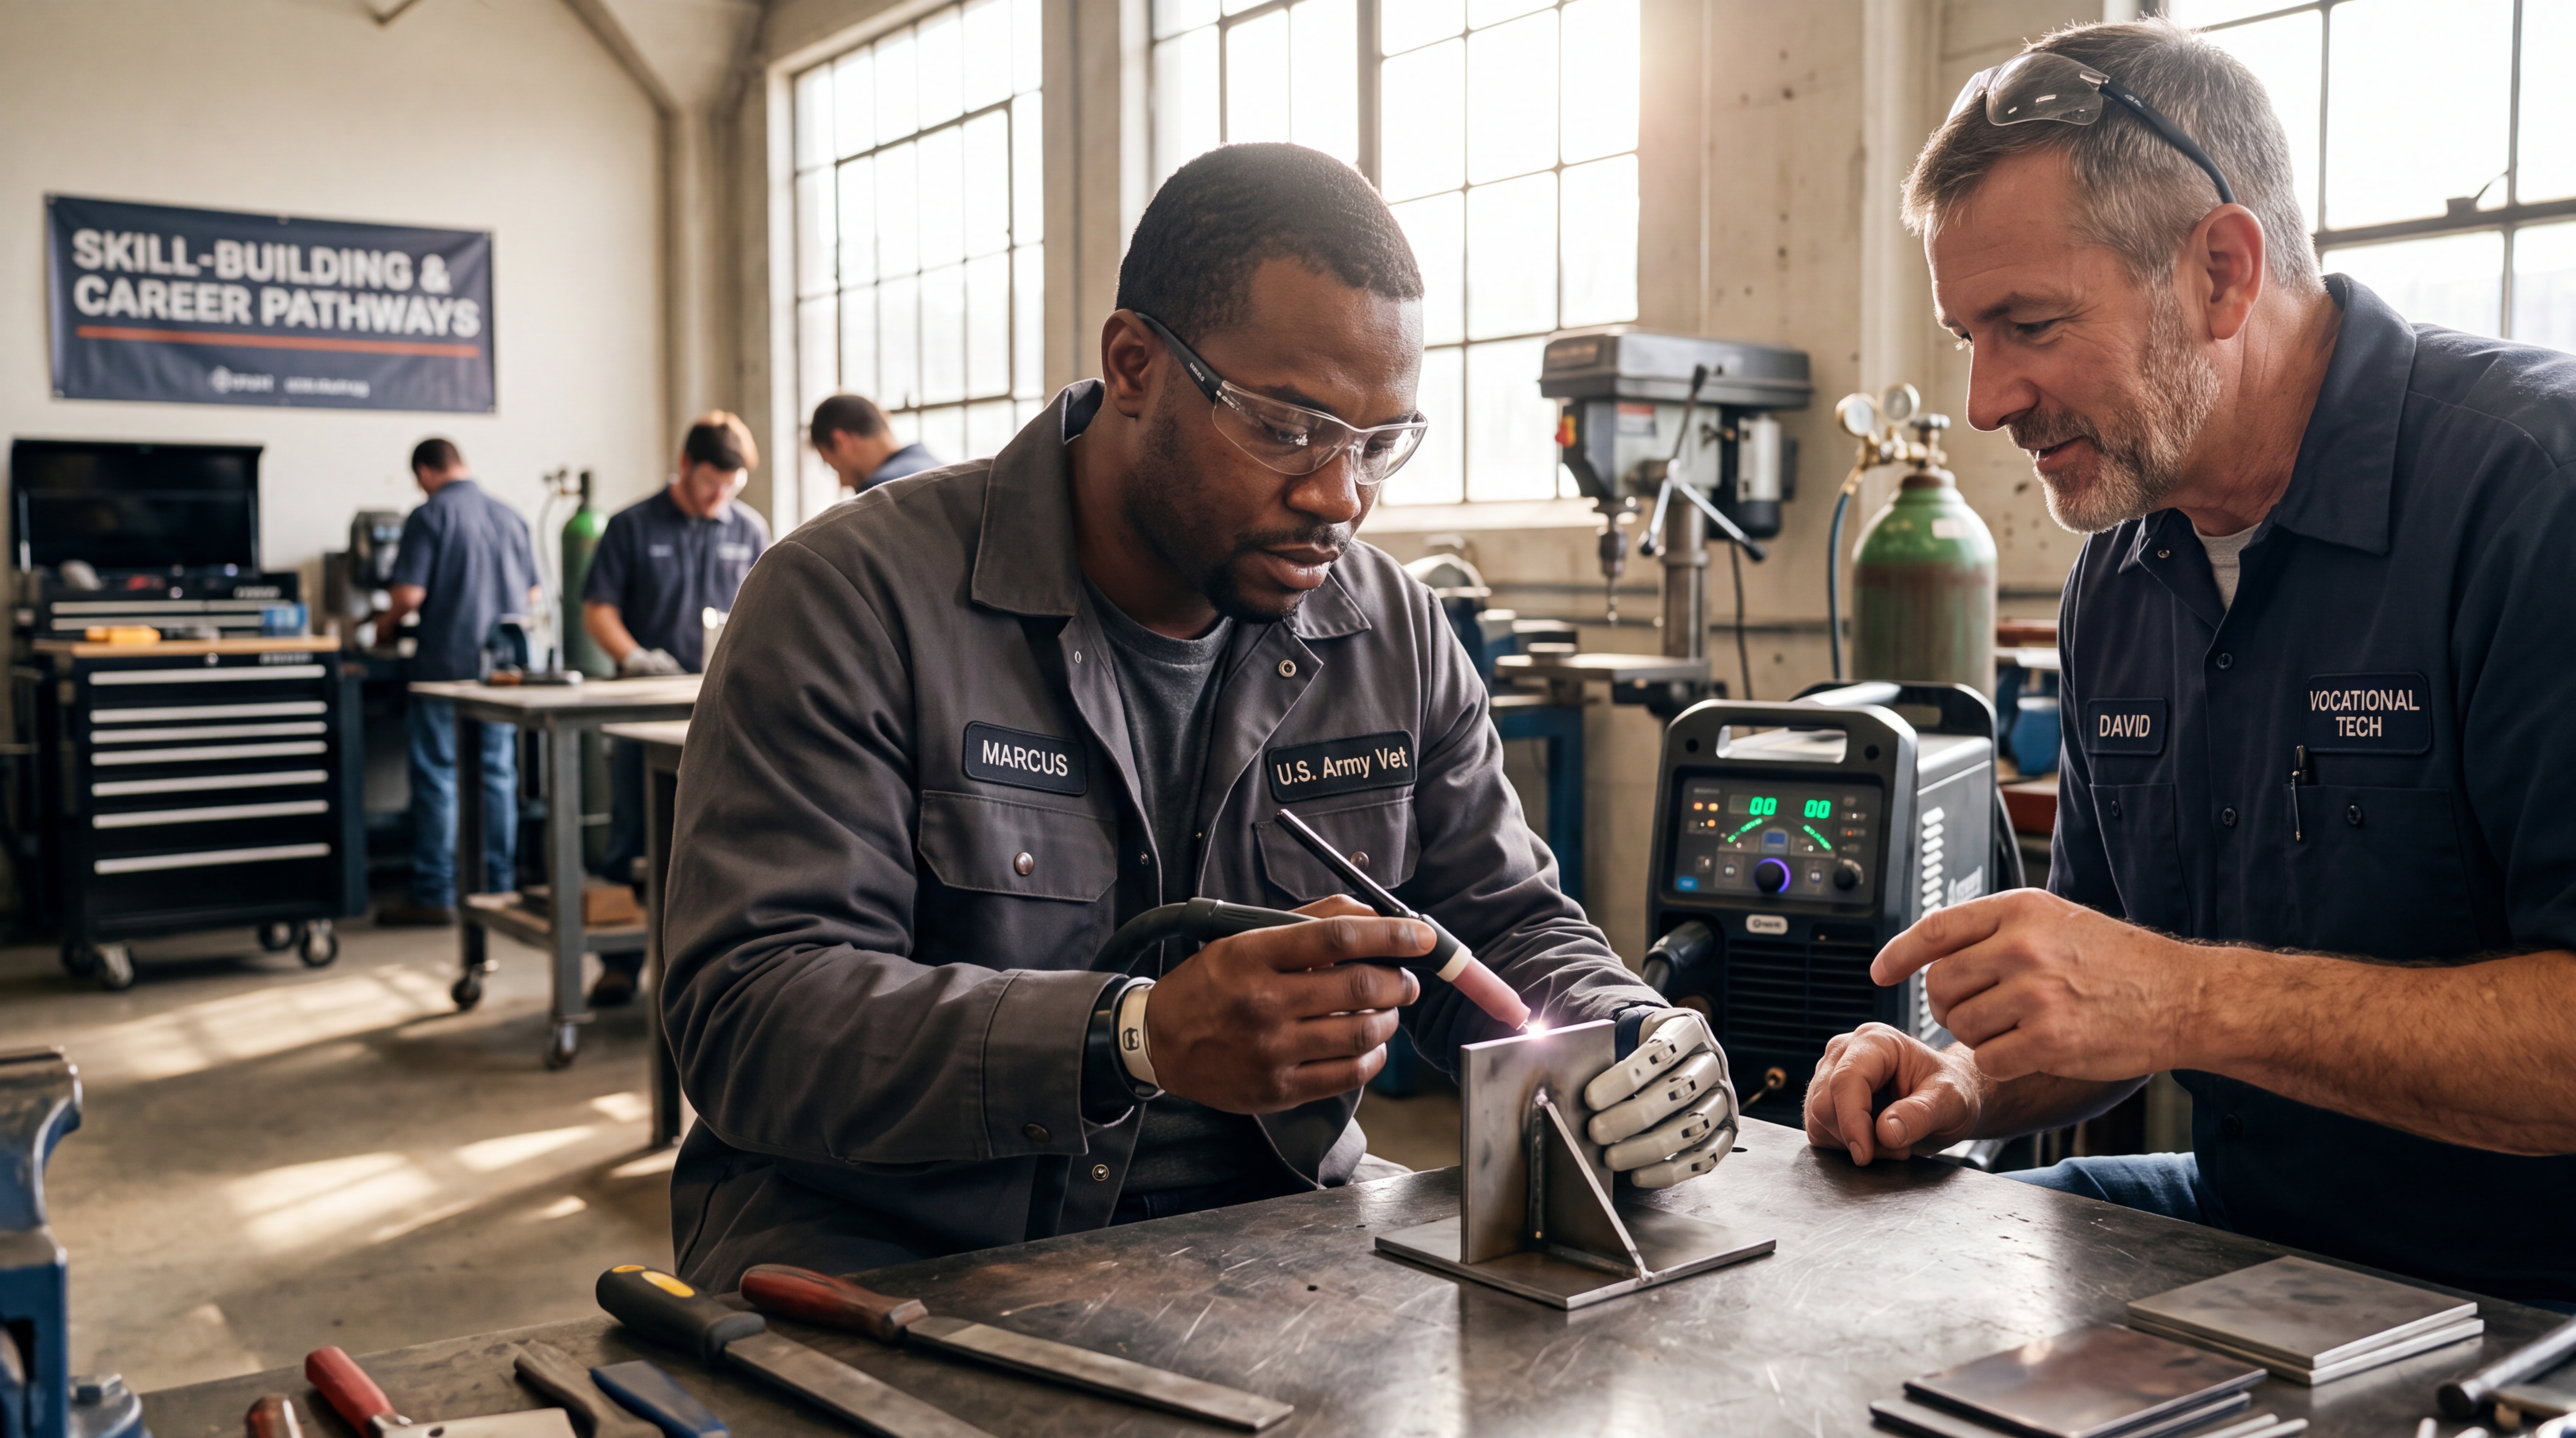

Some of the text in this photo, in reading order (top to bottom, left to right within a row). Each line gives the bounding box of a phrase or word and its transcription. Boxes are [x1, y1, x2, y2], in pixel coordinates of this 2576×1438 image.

[73, 229, 452, 294] SKILL-BUILDING &
[74, 275, 481, 338] CAREER PATHWAYS
[2310, 690, 2420, 711] VOCATIONAL
[2100, 714, 2150, 737] DAVID
[2335, 716, 2382, 737] TECH
[982, 740, 1068, 777] MARCUS
[1277, 746, 1408, 785] U.S. Army Vet
[1749, 797, 1777, 815] 00
[1804, 800, 1831, 819] 00
